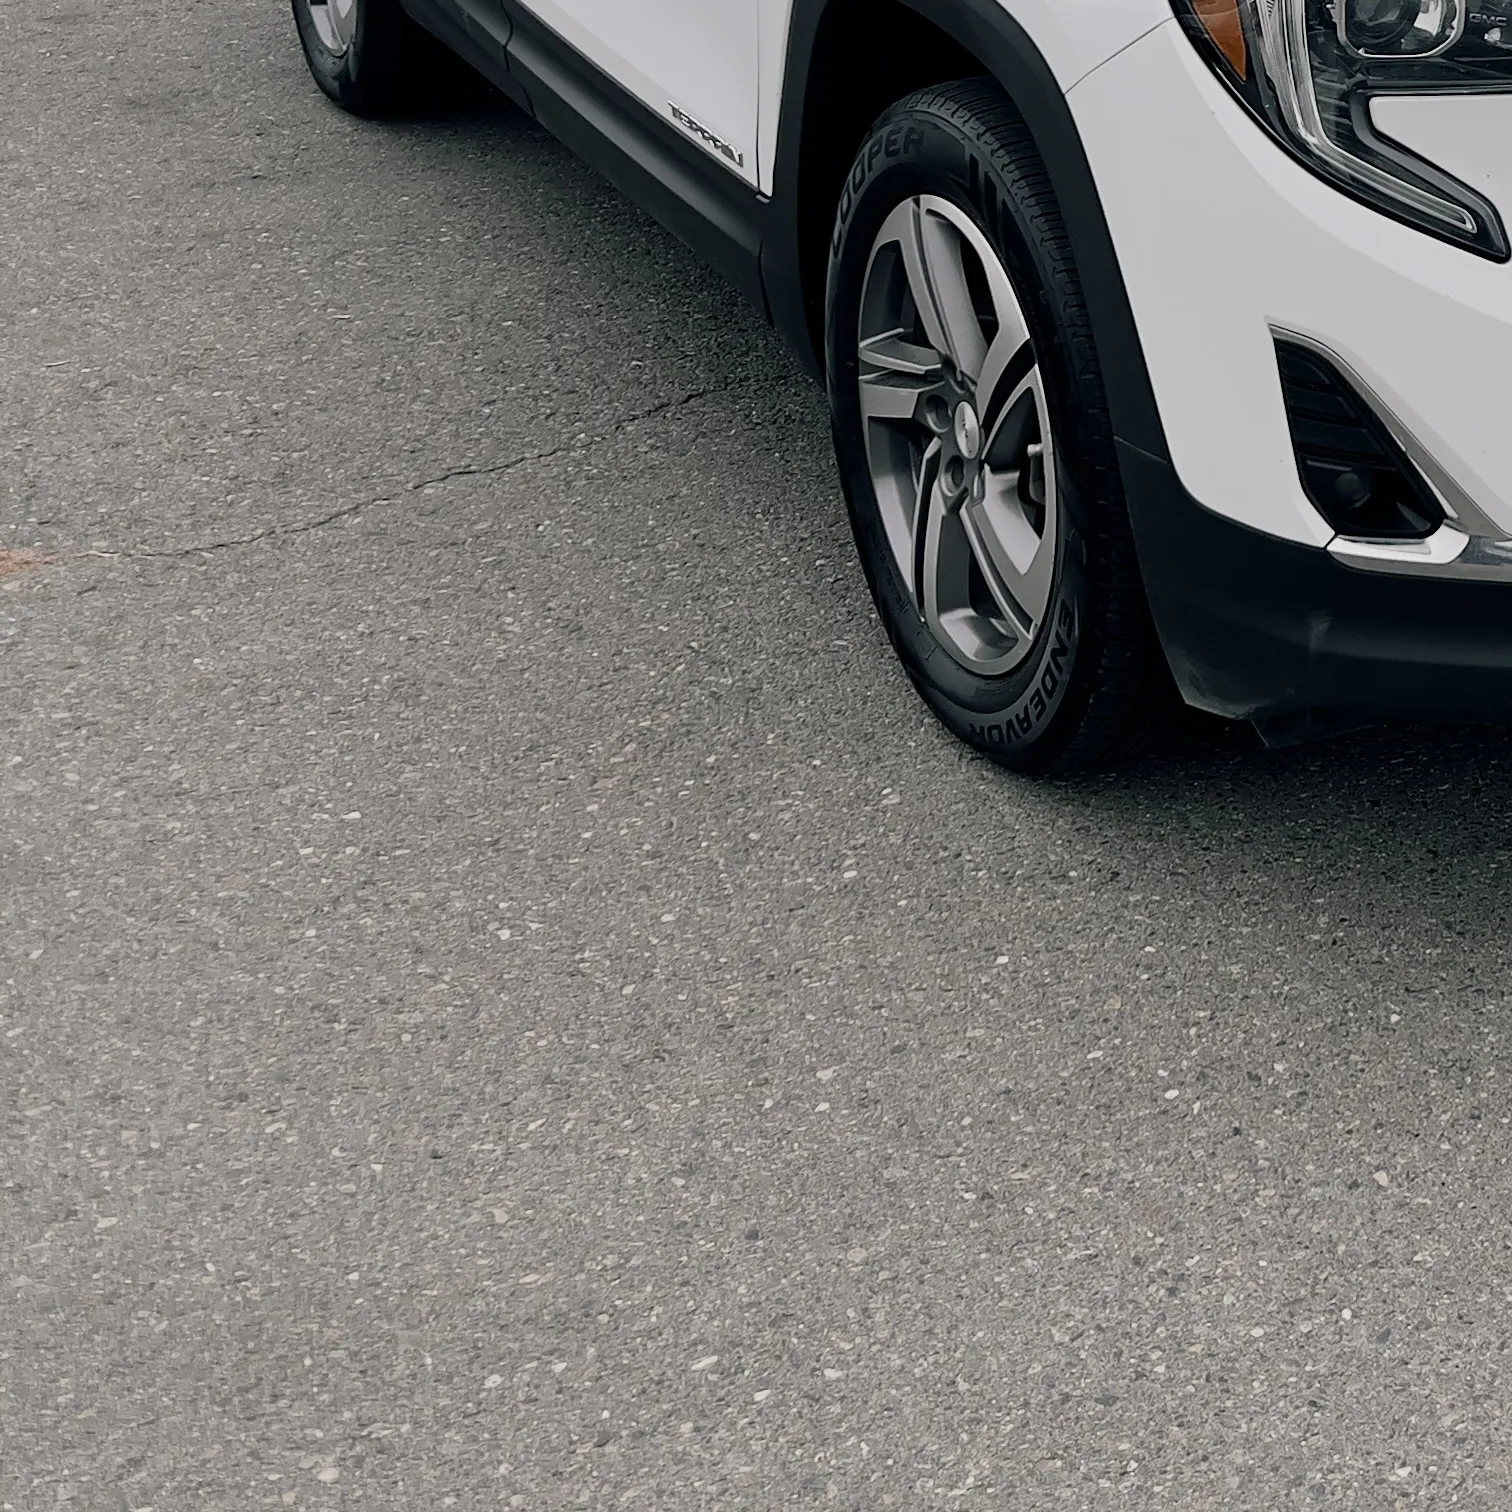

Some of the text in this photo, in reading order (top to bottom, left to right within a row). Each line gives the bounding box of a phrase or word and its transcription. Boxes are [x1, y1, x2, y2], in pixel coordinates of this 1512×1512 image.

[1469, 12, 1508, 27] GMC
[832, 126, 926, 259] COOPER
[969, 597, 1074, 746] ENDEAVOR
